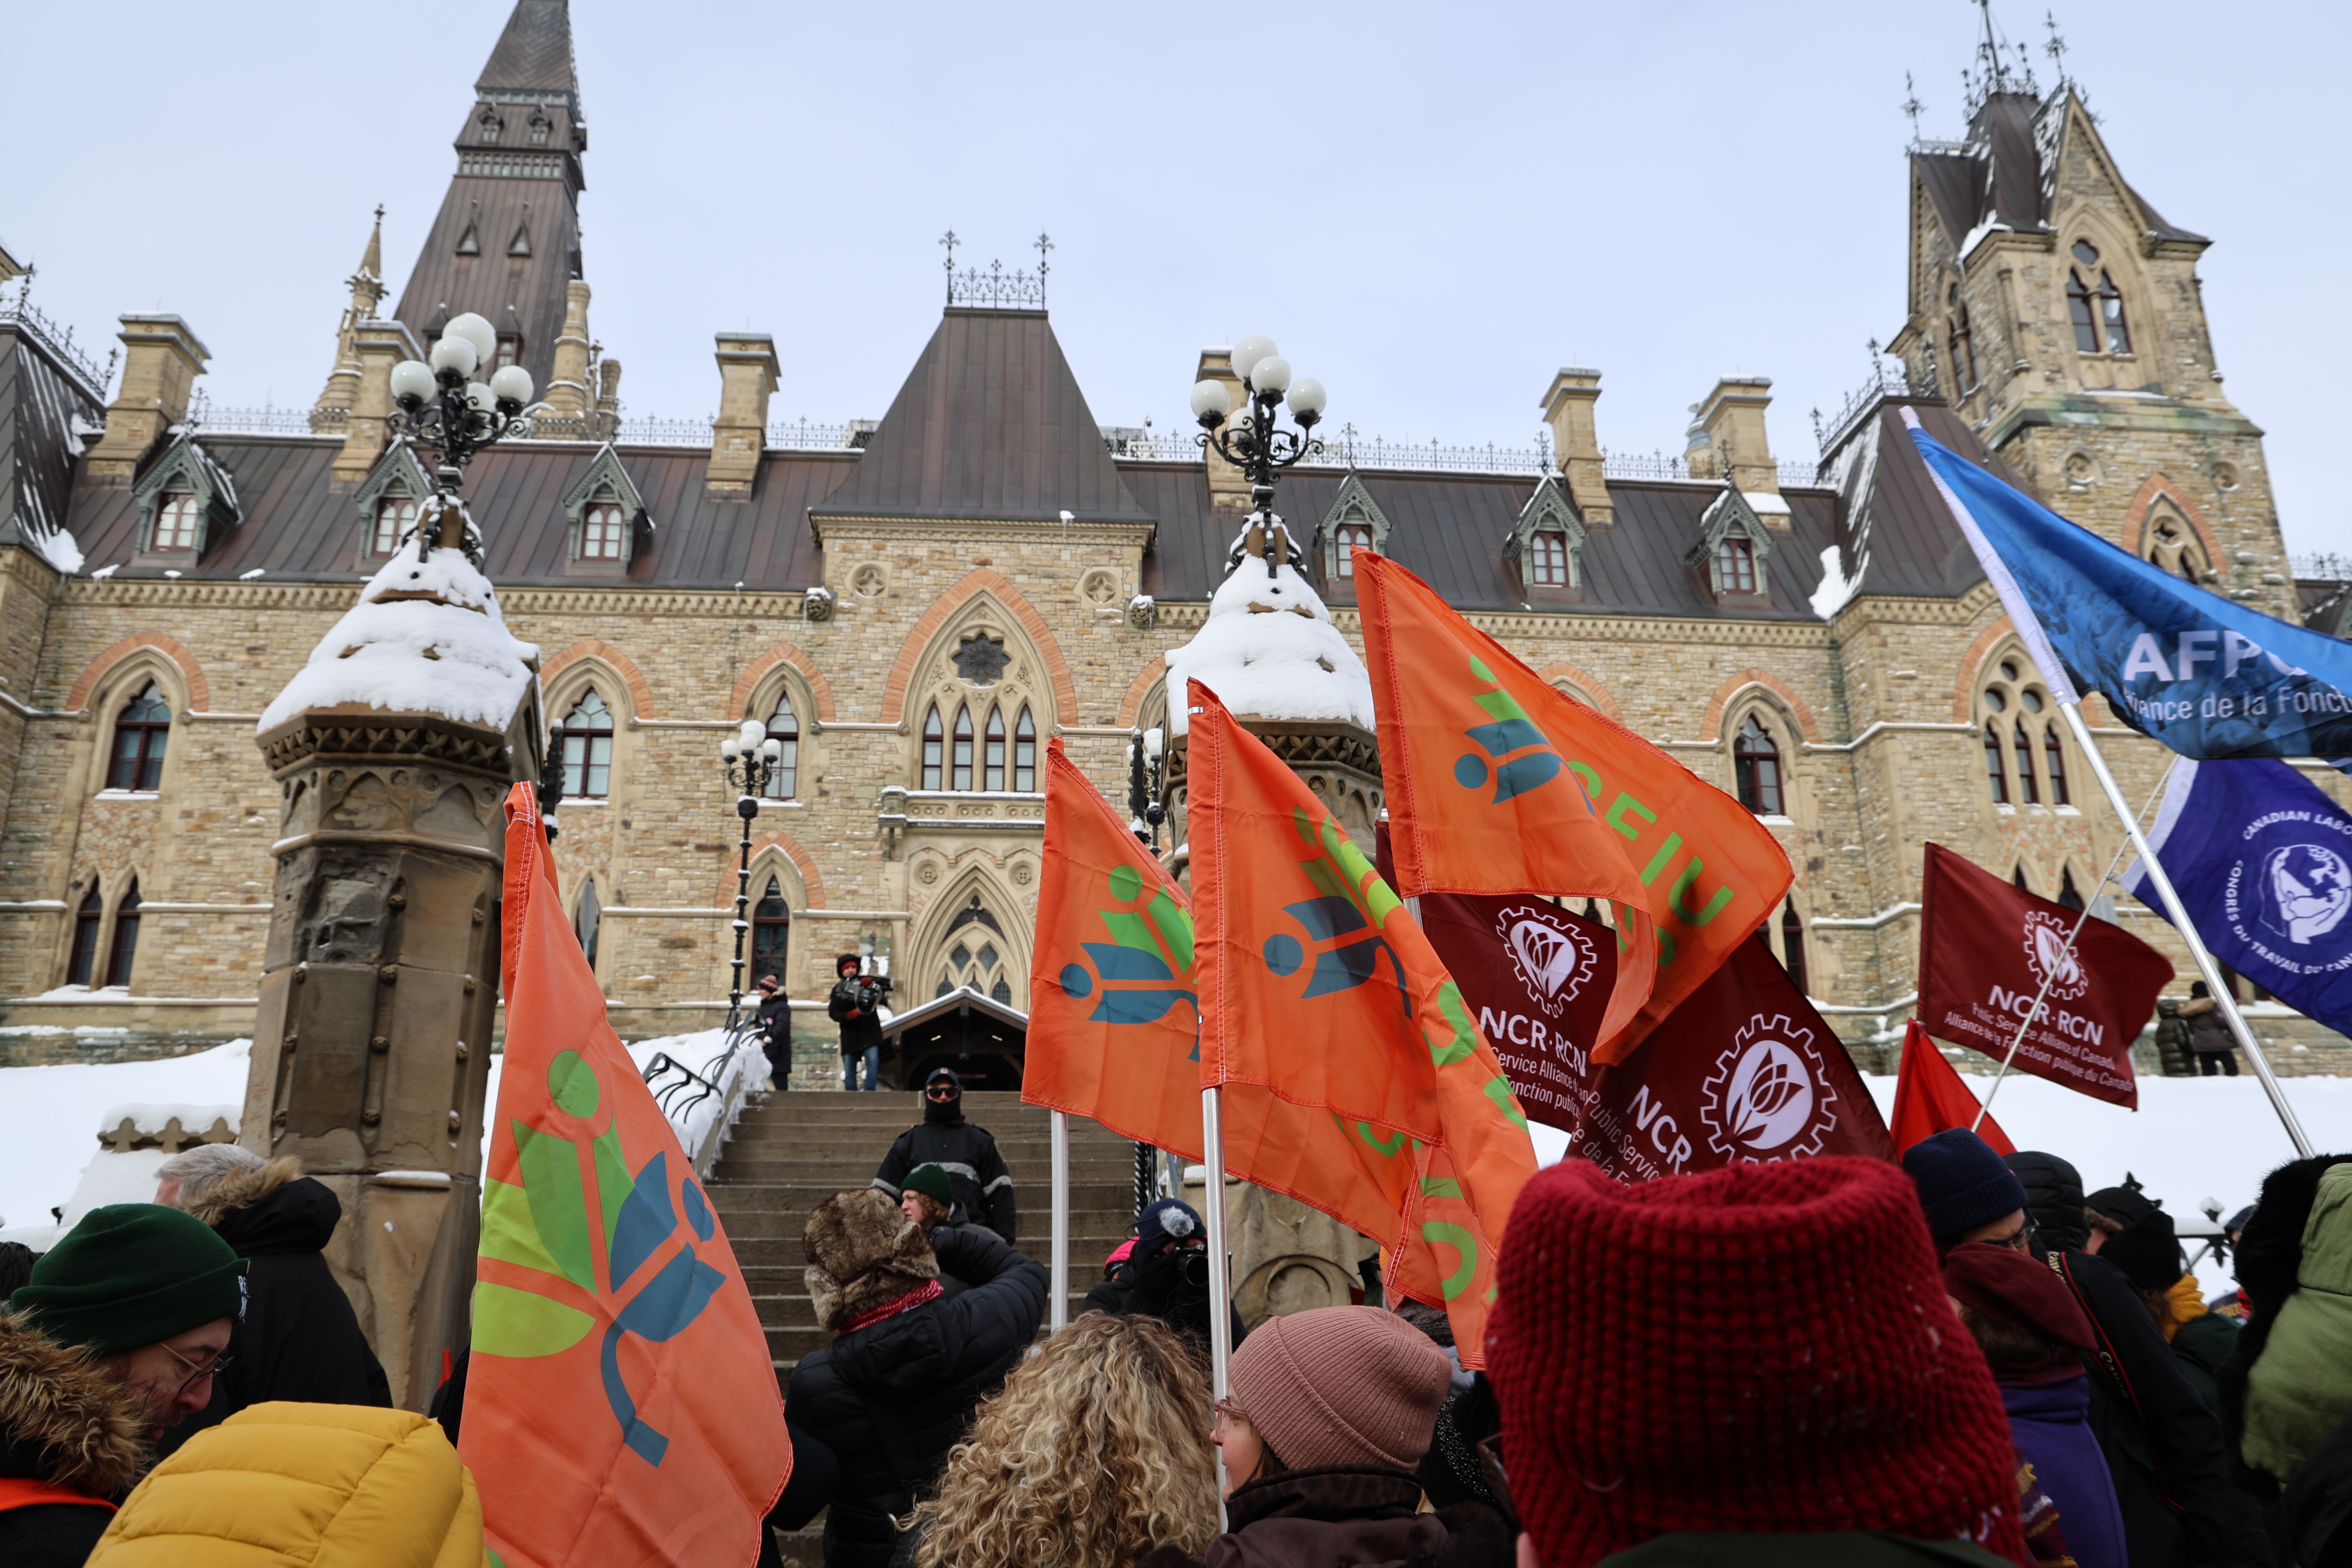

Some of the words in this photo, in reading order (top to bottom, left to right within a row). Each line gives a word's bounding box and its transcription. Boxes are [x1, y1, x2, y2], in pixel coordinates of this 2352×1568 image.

[2201, 692, 2234, 718] de
[2243, 691, 2267, 716] la
[2243, 810, 2311, 840] CANADIAN
[2233, 924, 2252, 942] DU
[2250, 941, 2300, 973] TRAVAIL
[2326, 953, 2352, 971] CAN
[1995, 1014, 2038, 1040] Servce
[1944, 1011, 1984, 1036] Alliance
[2084, 1068, 2099, 1082] du
[1505, 1074, 1553, 1104] onction
[1539, 1060, 1573, 1089] Alliance
[1583, 1141, 1602, 1163] de
[1584, 1091, 1622, 1142] Public
[1619, 1134, 1662, 1183] Servic
